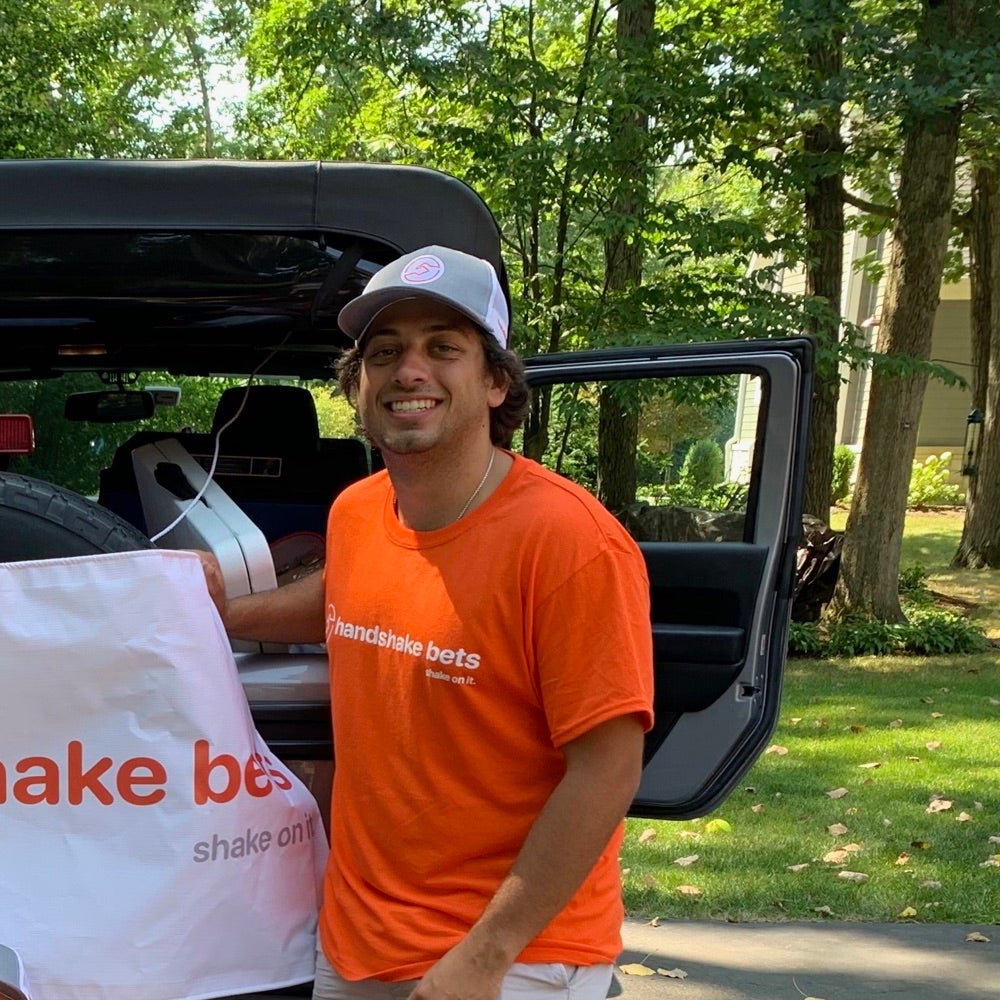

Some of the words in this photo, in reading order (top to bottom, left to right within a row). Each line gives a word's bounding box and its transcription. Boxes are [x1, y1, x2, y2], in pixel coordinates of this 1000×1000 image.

[334, 616, 424, 657] handshake
[426, 641, 481, 670] bets
[451, 676, 465, 684] on
[193, 739, 292, 805] bes
[192, 827, 272, 863] shake
[278, 822, 303, 847] on
